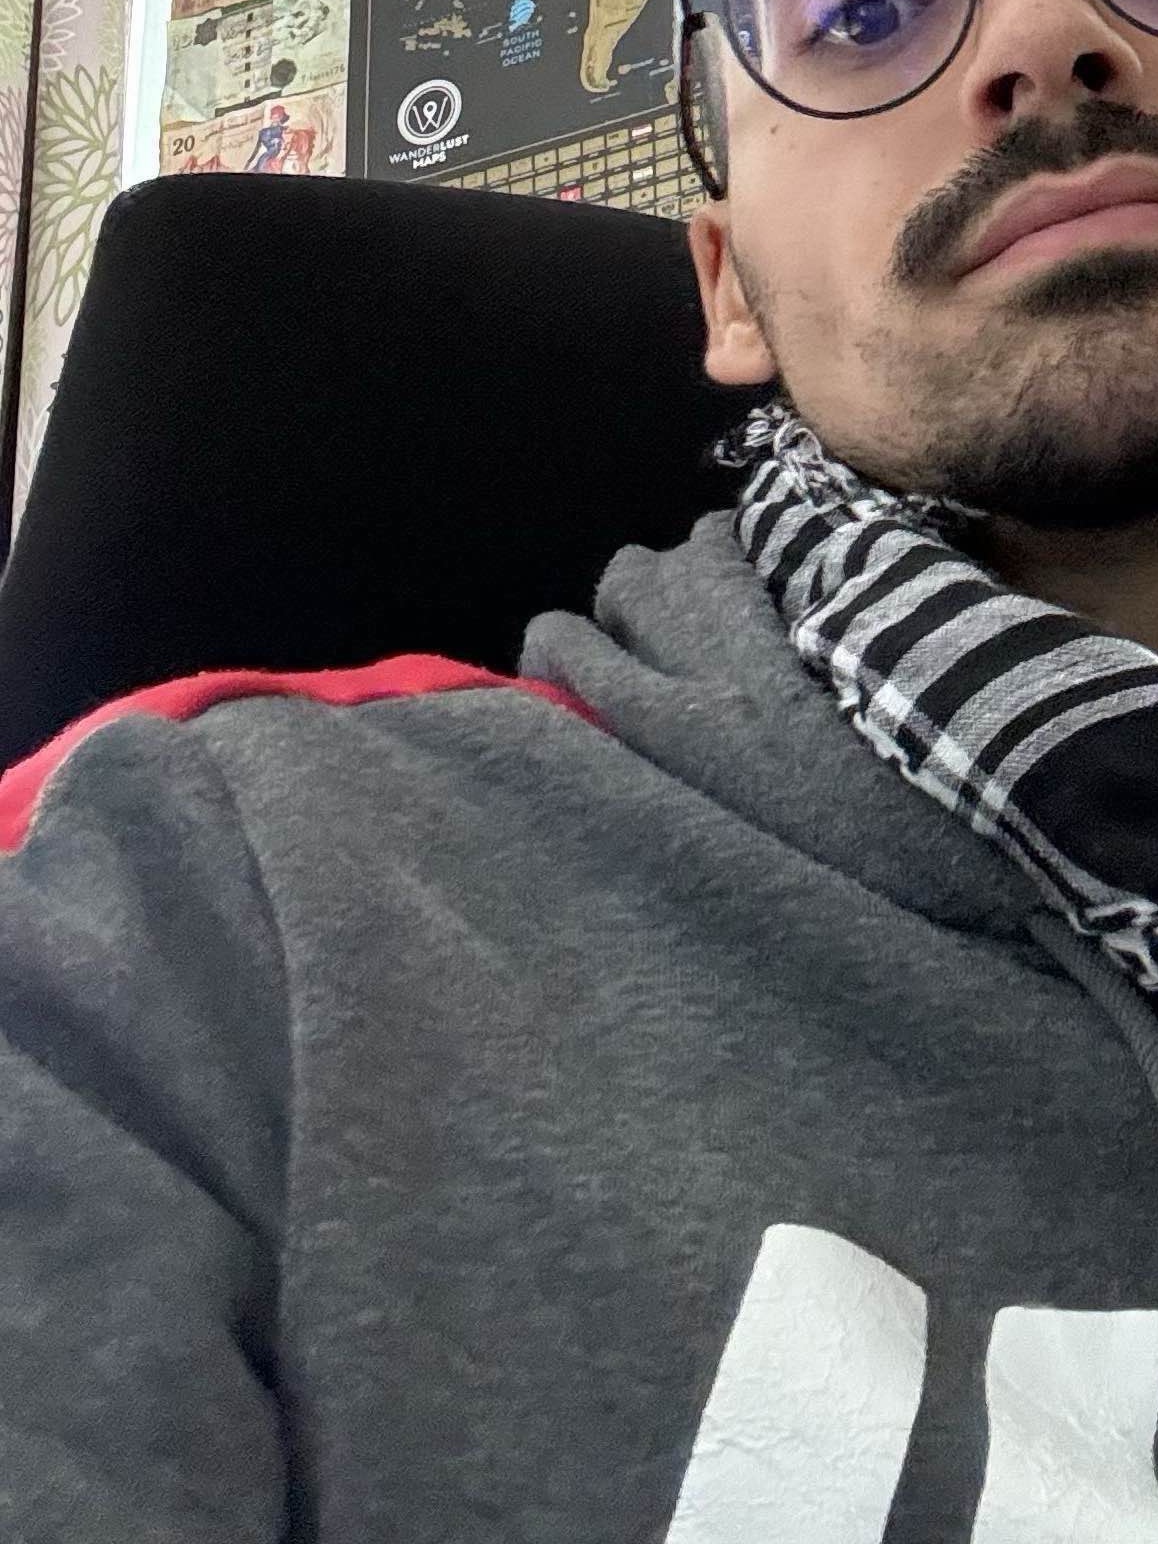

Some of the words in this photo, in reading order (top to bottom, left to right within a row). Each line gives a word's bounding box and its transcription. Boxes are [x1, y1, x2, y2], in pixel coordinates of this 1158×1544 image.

[503, 29, 540, 47] SOUTH
[500, 38, 543, 58] PACIFIC
[502, 49, 540, 67] OCEAN
[172, 134, 196, 157] 20
[389, 134, 470, 164] WANDERLUST
[412, 151, 447, 169] MAPS
